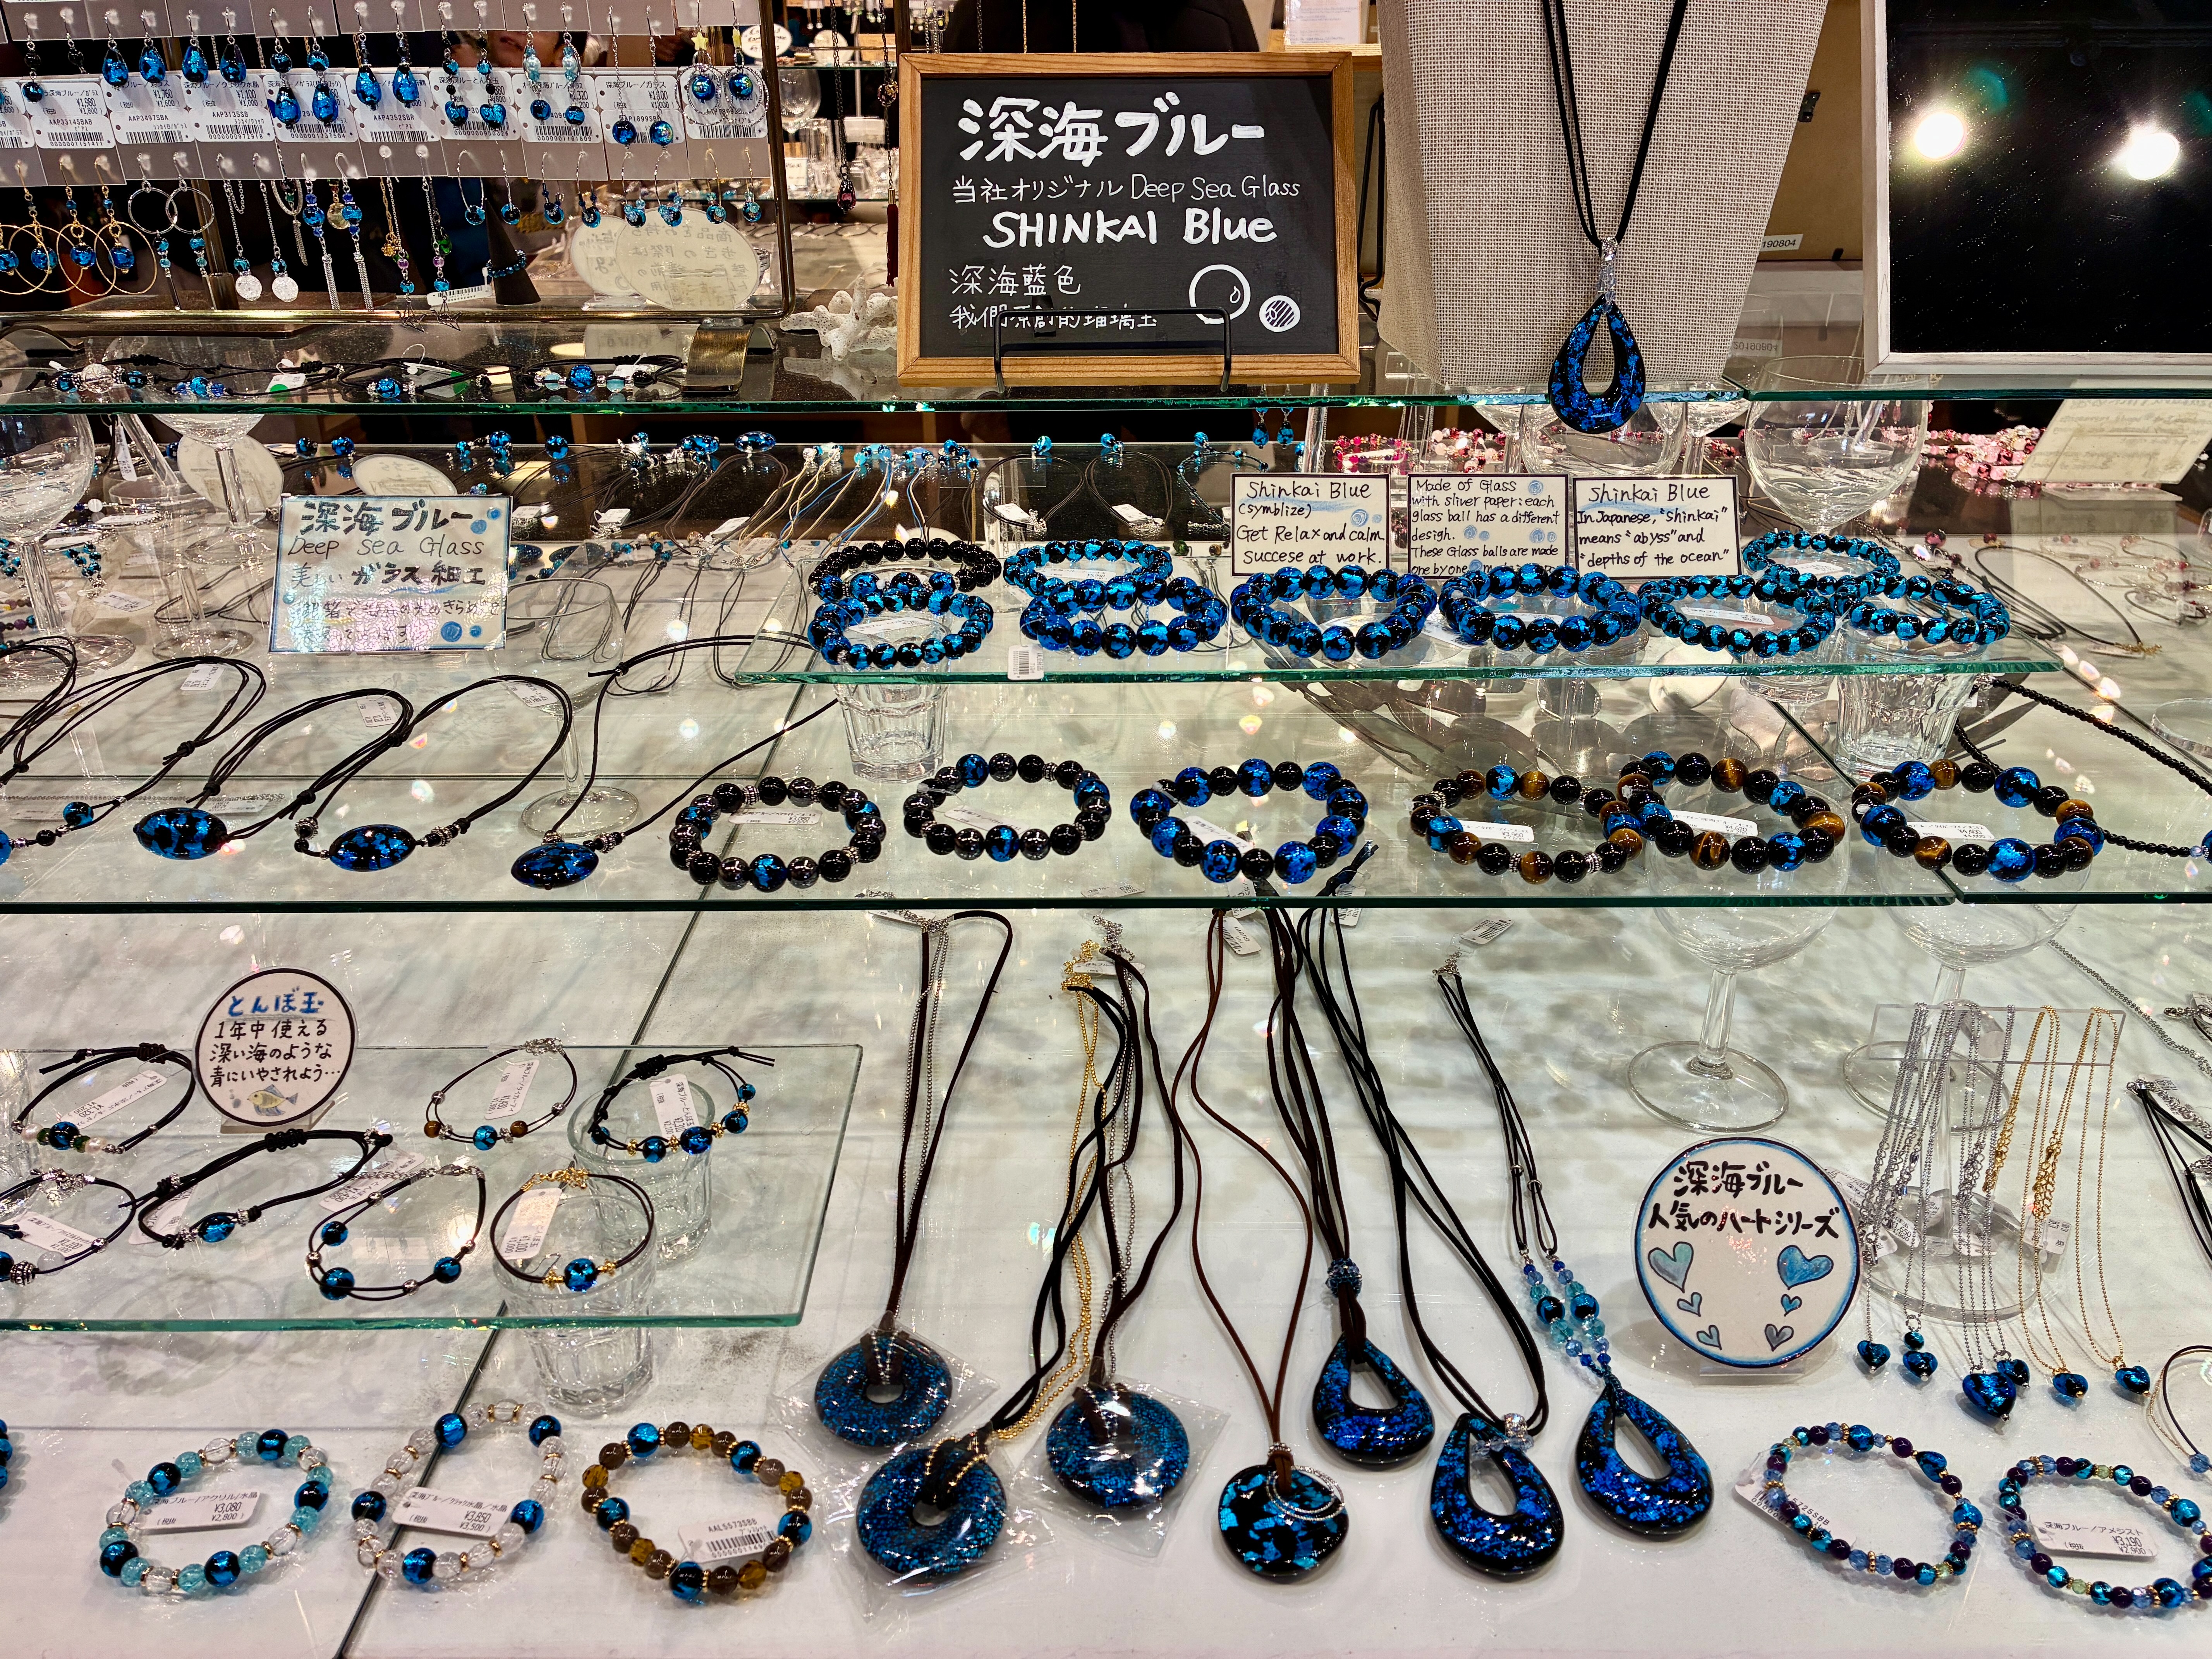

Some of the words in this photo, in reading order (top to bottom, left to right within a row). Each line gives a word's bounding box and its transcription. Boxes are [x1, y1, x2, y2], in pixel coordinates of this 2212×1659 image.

[76, 98, 96, 108] ¥1,980
[153, 89, 173, 99] ¥1,760
[236, 89, 256, 100] ¥1,100
[959, 92, 1265, 167] 深海ブルー
[952, 175, 1123, 204] 当社オリジナル
[1132, 174, 1185, 203] Deep
[1191, 177, 1237, 199] Sea
[1242, 175, 1301, 198] Glass
[983, 210, 1158, 248] SHINKAI
[1183, 207, 1278, 245] Blue
[949, 264, 1081, 296] 深海藍色
[1247, 481, 1319, 499] Shinkai
[1330, 481, 1372, 499] Blue
[1417, 478, 1451, 492] Made
[1458, 478, 1473, 491] of
[1479, 479, 1516, 494] Glass
[1589, 483, 1657, 504] Shinkai
[1667, 483, 1711, 502] Blue
[1412, 493, 1440, 507] with
[300, 499, 473, 537] 深海ブルー
[1412, 510, 1443, 523] glass
[1448, 509, 1470, 522] ball
[1476, 510, 1495, 522] has
[1500, 514, 1510, 523] a
[1512, 511, 1560, 525] different
[1577, 511, 1594, 524] In
[1597, 510, 1656, 526] Japanese,
[1237, 525, 1269, 541] Get
[1275, 526, 1321, 544] Relax
[1323, 522, 1347, 541] and
[1579, 533, 1622, 545] means
[1678, 527, 1705, 542] and
[288, 536, 339, 559] Deep
[420, 534, 485, 557] Glass
[1411, 544, 1444, 558] These
[1447, 546, 1479, 557] Glass
[1483, 544, 1508, 557] balls
[1510, 547, 1528, 557] are
[1532, 546, 1559, 557] made
[1309, 550, 1327, 565] at
[1336, 547, 1382, 565] work.
[1634, 551, 1648, 567] of
[1655, 553, 1674, 566] the
[1412, 565, 1430, 575] one
[1434, 563, 1448, 577] by
[1448, 564, 1468, 575] one
[228, 986, 324, 1017] とんぼ玉
[215, 1019, 327, 1040] 1年中使える
[210, 1043, 332, 1063] 深い海のような
[1674, 1161, 1803, 1198] 深海ブルー
[1648, 1200, 1840, 1239] 人気のハートシリーズ
[214, 1502, 242, 1513] ¥3,080
[464, 1510, 492, 1523] ¥3,850
[211, 1513, 237, 1522] ¥2,800
[459, 1521, 485, 1532] ¥3,500
[2112, 1535, 2142, 1547] ¥3,190
